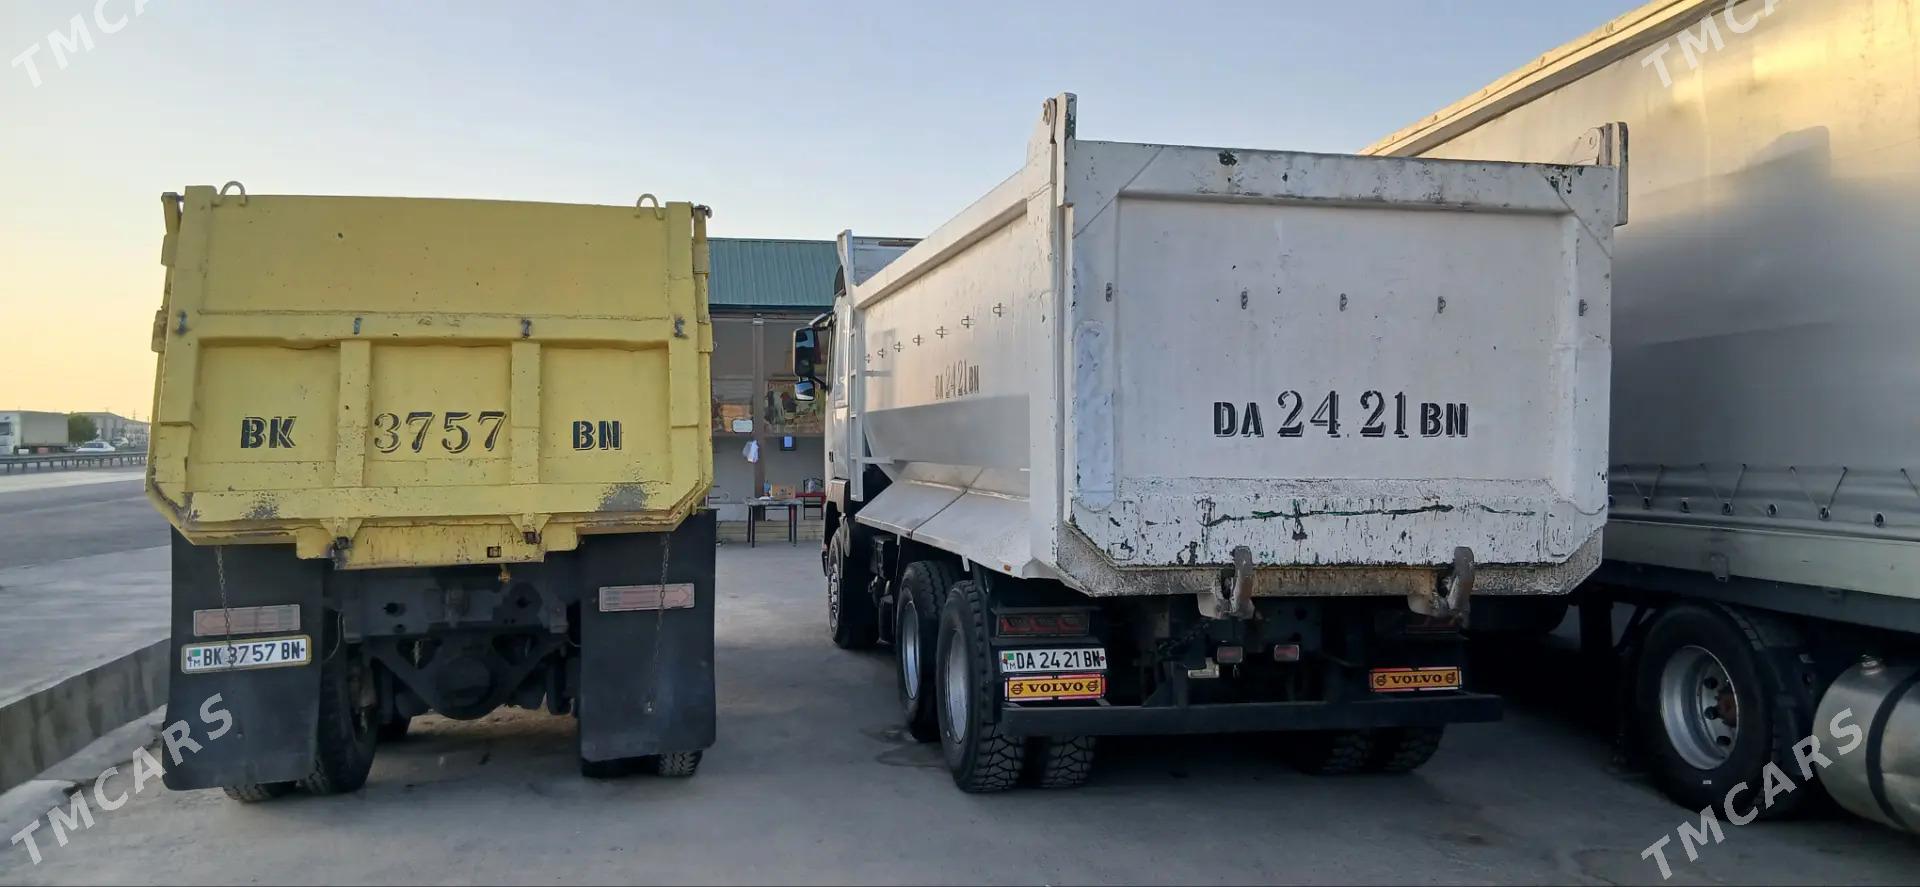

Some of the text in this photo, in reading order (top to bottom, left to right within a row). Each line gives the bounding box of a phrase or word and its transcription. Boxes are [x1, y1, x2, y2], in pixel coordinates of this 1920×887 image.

[1213, 401, 1265, 438] DA
[1419, 402, 1469, 438] BN
[240, 411, 622, 454] BK 3757 BN
[203, 648, 222, 666] BK
[281, 641, 301, 660] BN
[1016, 652, 1036, 669] DA
[1083, 650, 1101, 667] BN
[1028, 682, 1083, 693] VOLVO
[1391, 674, 1442, 684] VOLVO
